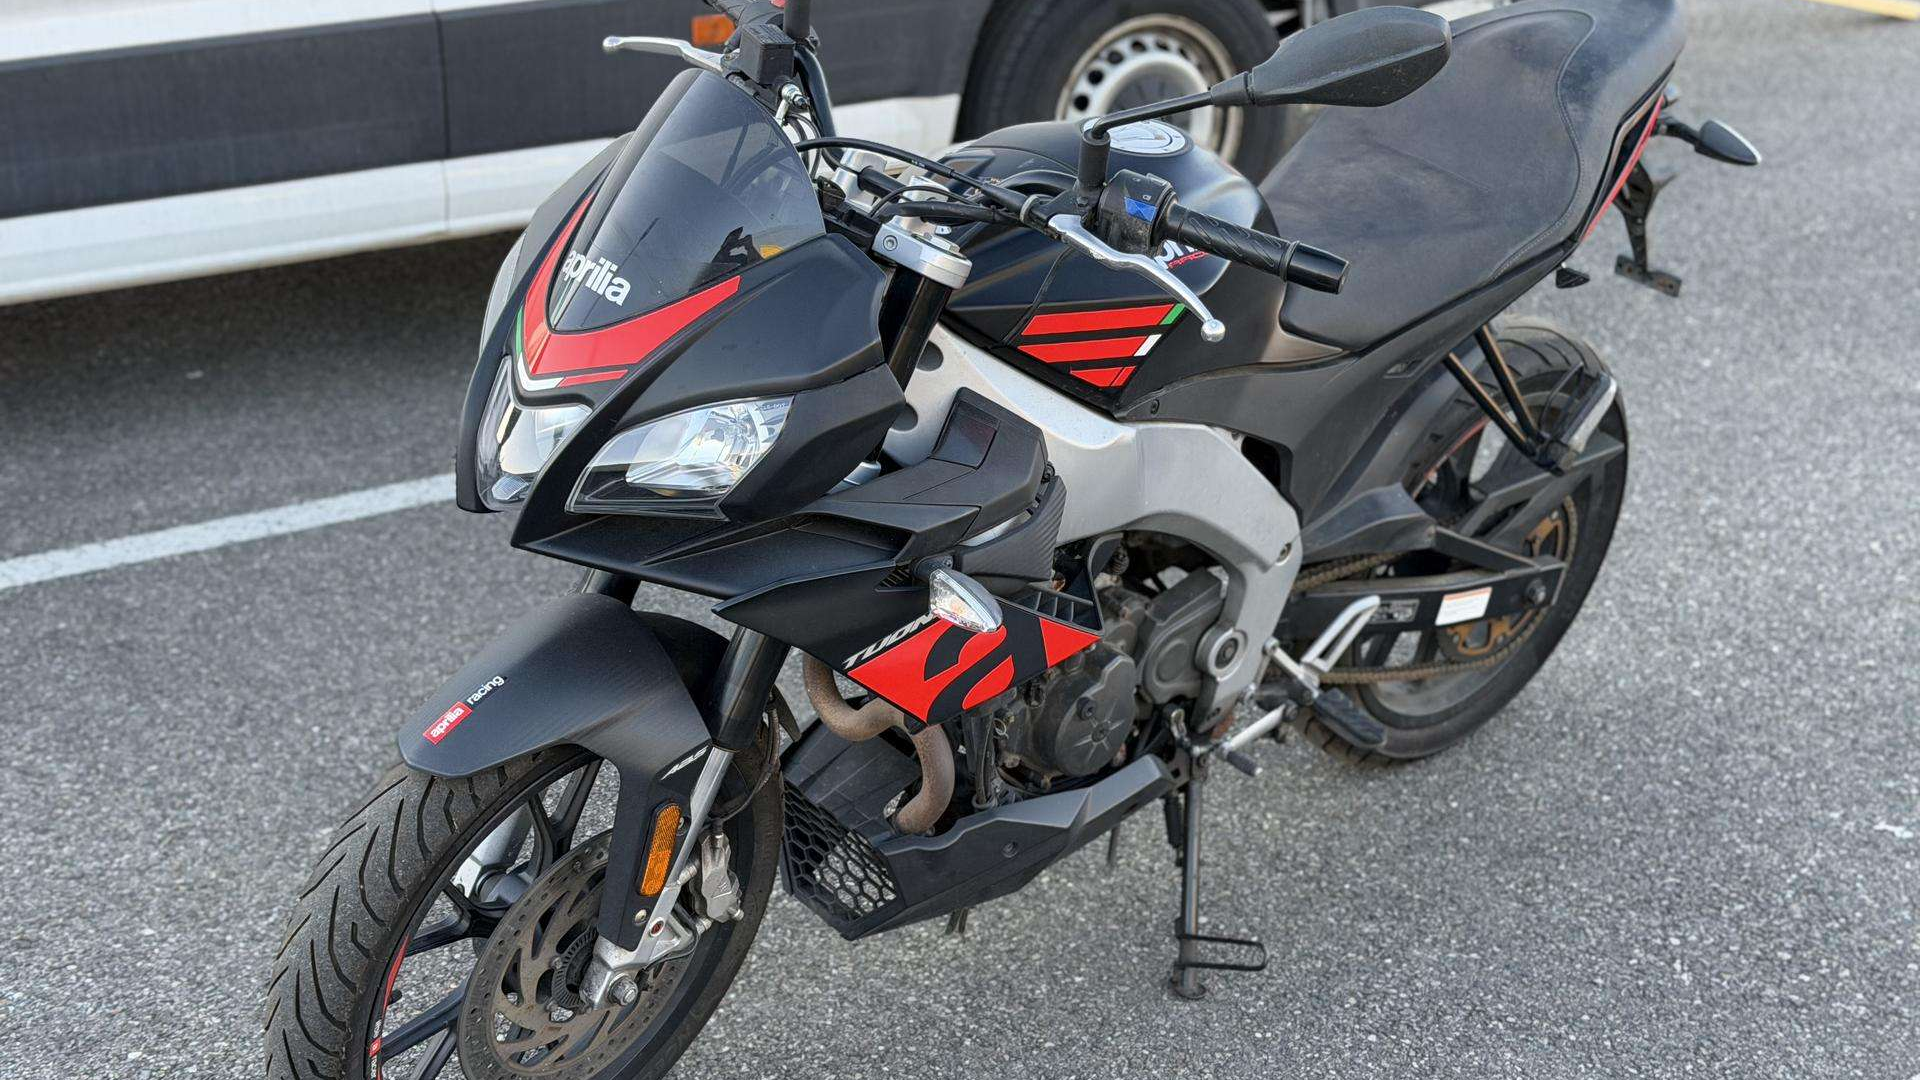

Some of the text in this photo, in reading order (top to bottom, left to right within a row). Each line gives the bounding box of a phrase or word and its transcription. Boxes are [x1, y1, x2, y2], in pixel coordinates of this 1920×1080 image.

[562, 250, 631, 306] aprilia
[843, 614, 935, 668] TUON
[430, 675, 505, 738] aprilia racing
